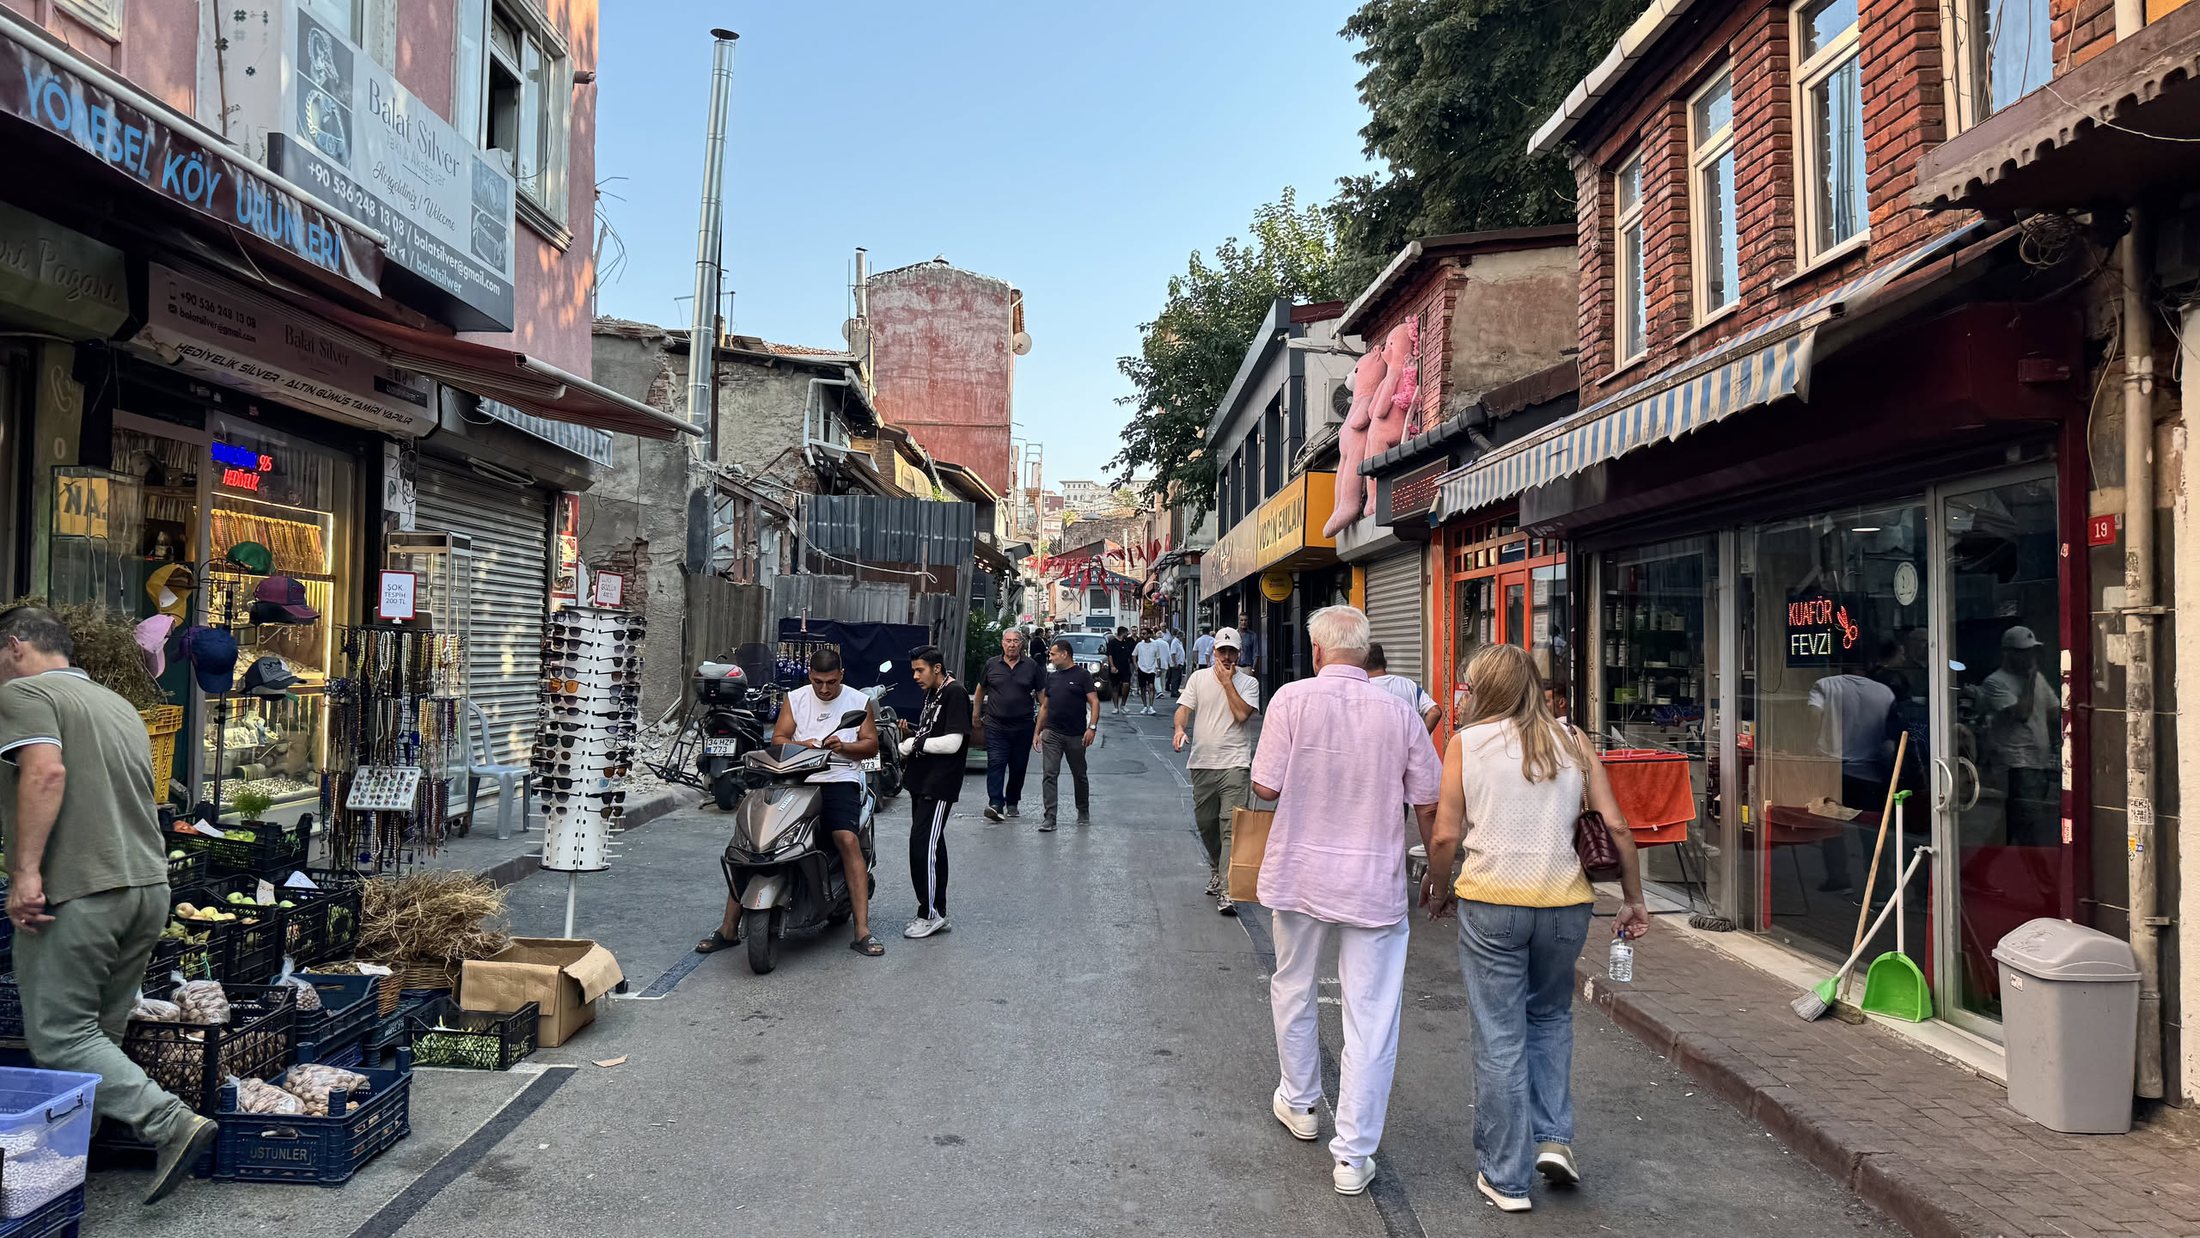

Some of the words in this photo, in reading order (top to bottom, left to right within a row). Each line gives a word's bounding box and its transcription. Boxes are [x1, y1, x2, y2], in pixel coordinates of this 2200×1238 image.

[369, 78, 412, 143] Balat
[417, 119, 460, 177] Silver
[162, 149, 222, 209] KÖY
[308, 161, 330, 188] +90
[333, 175, 354, 203] 536
[356, 191, 376, 218] 248
[380, 206, 390, 227] 13
[392, 215, 405, 237] 08
[414, 228, 501, 297] balatsilver@gmail.com
[416, 253, 462, 295] balatsilwer
[180, 292, 197, 306] +90
[199, 298, 215, 313] 536
[217, 304, 233, 320] 248
[236, 311, 245, 324] 13
[175, 342, 241, 369] HEDİYELİK
[238, 363, 280, 382] SİLVER
[284, 324, 315, 354] Balat
[319, 335, 350, 367] Silver
[2094, 522, 2108, 538] 19
[1788, 595, 1833, 627] KUAFÖR
[1791, 628, 1831, 656] FEVZİ
[708, 738, 718, 746] 34
